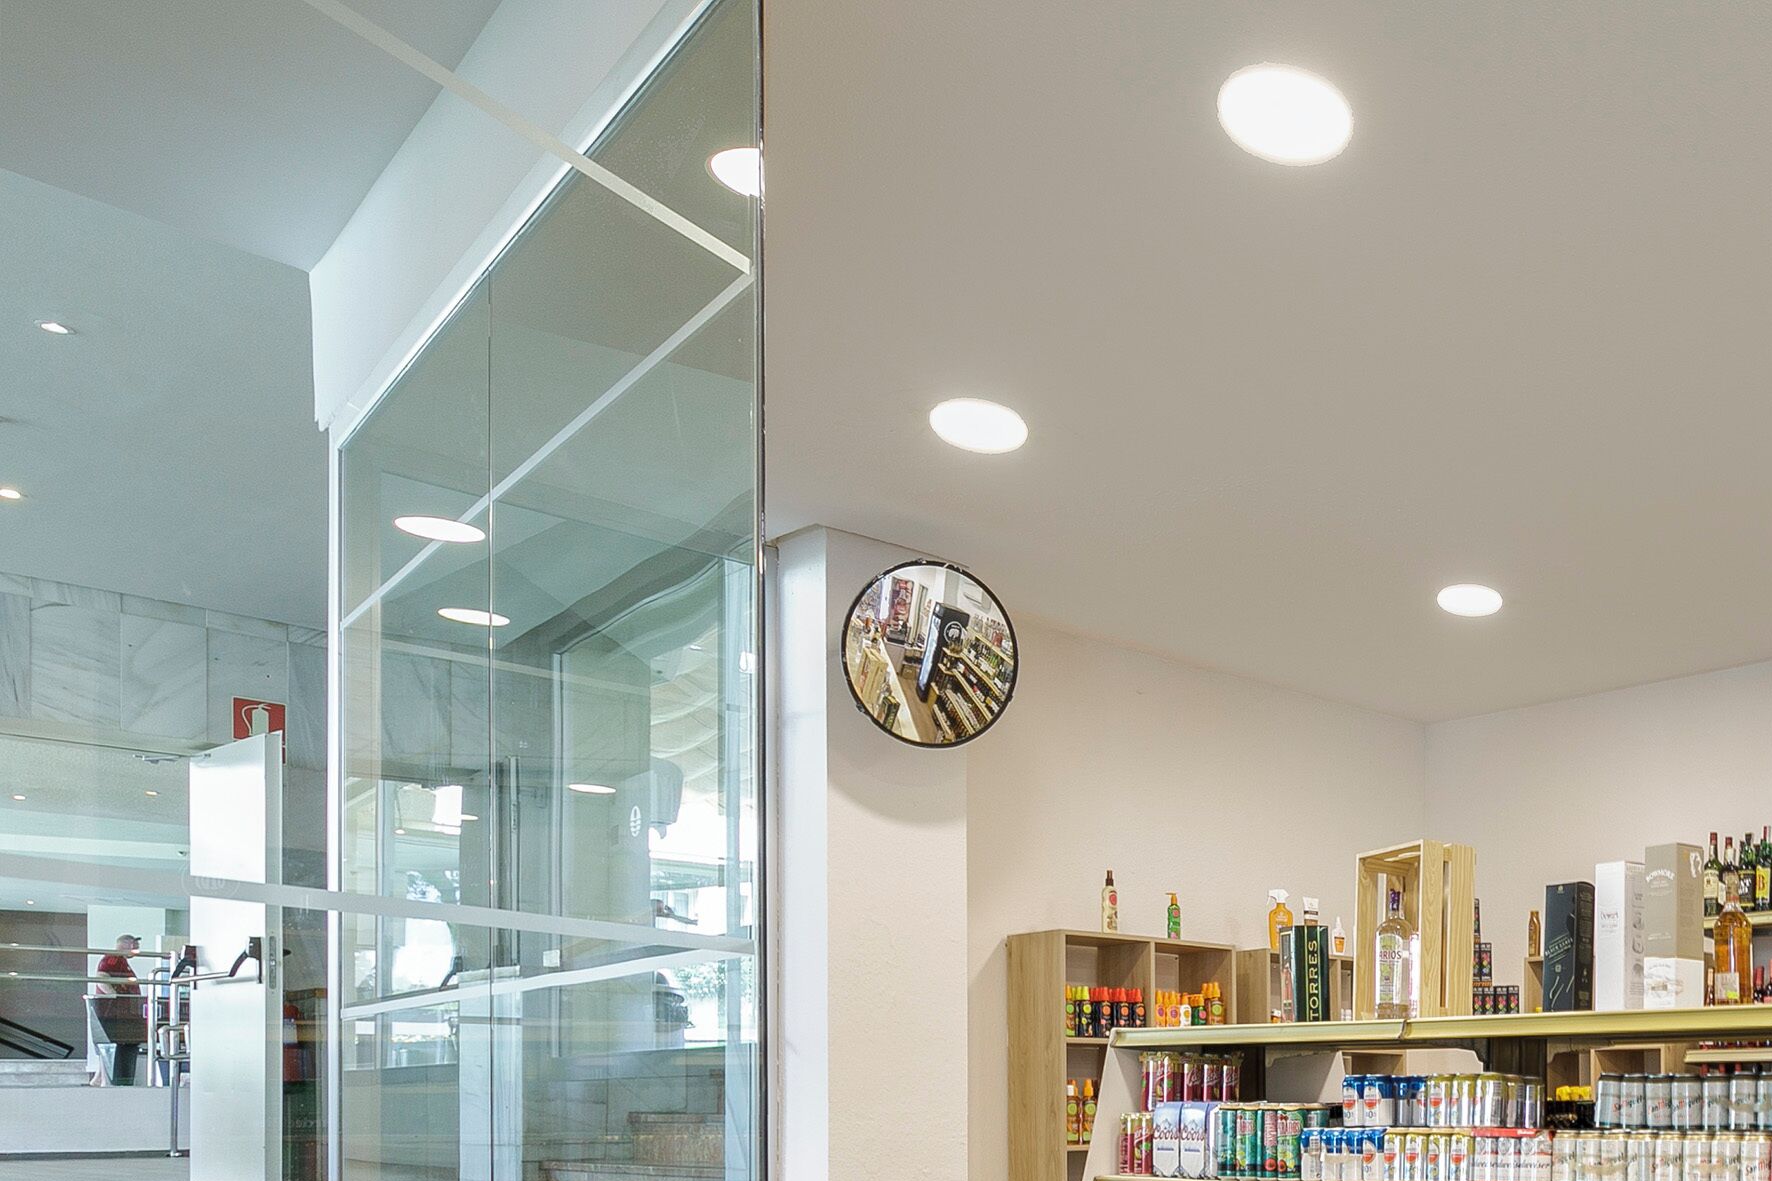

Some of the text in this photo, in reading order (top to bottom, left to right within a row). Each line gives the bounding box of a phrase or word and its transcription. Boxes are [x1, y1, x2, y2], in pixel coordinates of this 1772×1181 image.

[1308, 939, 1319, 1021] TORRES
[1153, 1125, 1179, 1141] Coors
[1180, 1126, 1206, 1142] Coors
